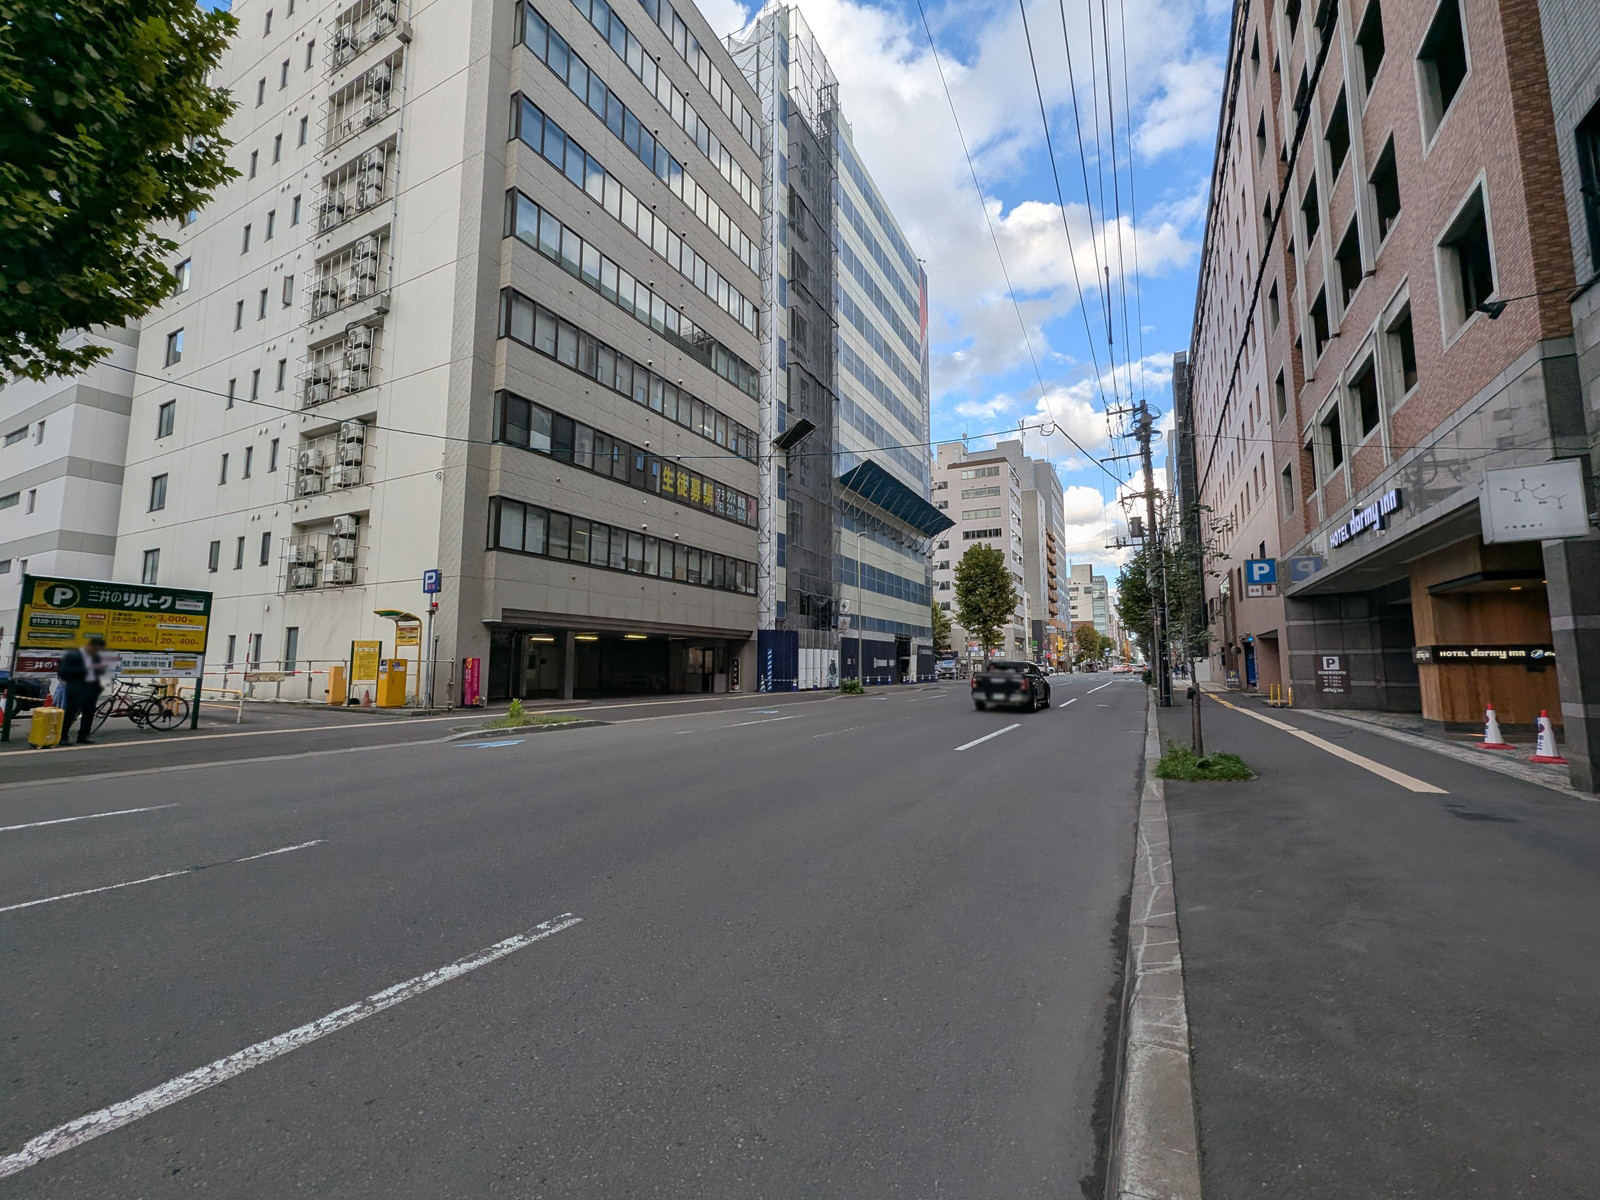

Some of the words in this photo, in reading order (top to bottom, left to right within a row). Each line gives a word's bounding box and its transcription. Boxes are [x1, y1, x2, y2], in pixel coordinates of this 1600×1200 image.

[662, 466, 714, 506] 生徒募集
[1329, 523, 1350, 549] HOTEL
[1349, 501, 1380, 536] dormy
[1380, 489, 1398, 517] inn
[425, 571, 436, 591] P
[1252, 562, 1270, 581] P
[53, 587, 74, 605] P
[87, 589, 173, 609] 三井のリパーク
[1325, 657, 1336, 669] P
[1470, 648, 1507, 659] dormy
